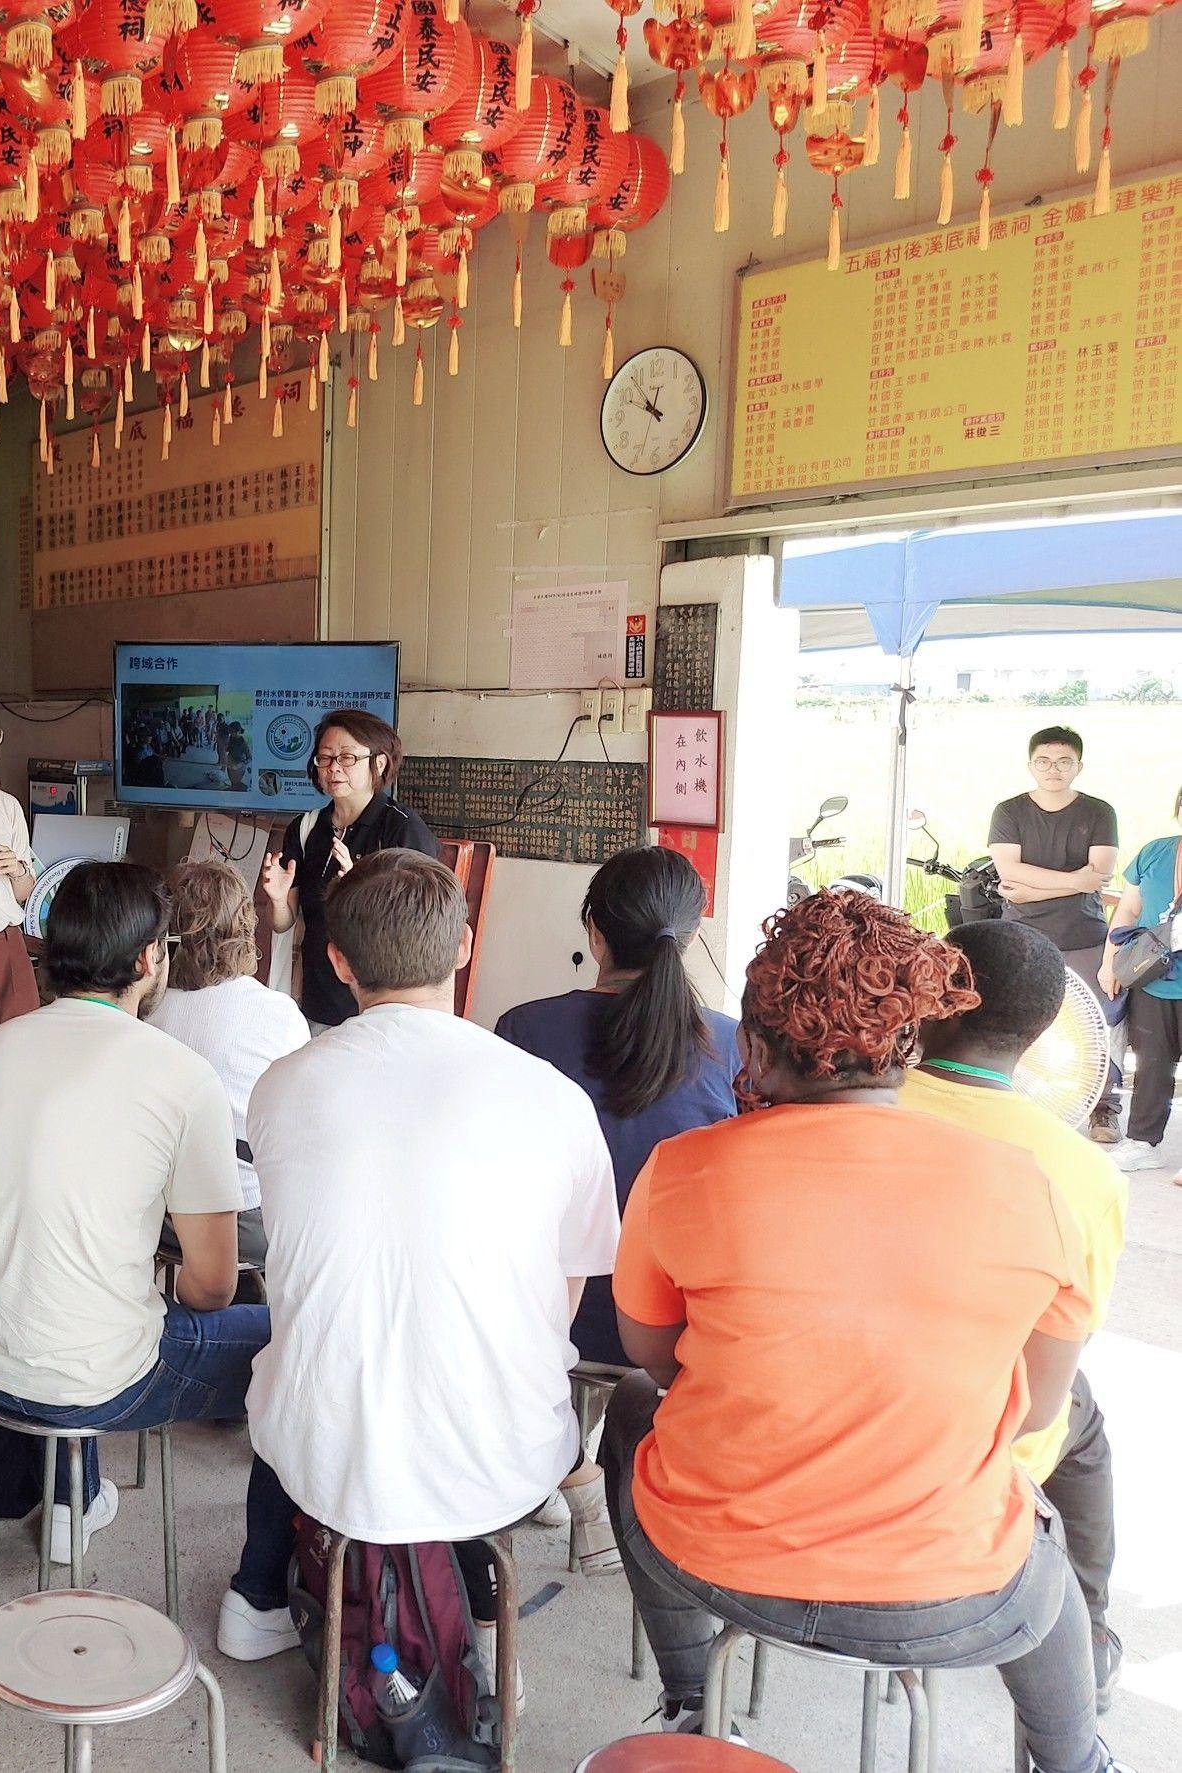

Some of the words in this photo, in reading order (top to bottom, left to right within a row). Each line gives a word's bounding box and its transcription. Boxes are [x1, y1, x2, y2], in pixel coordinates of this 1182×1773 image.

[483, 41, 515, 129] 國泰民安
[577, 108, 604, 187] 國泰民安
[129, 657, 178, 670] 跨域合作
[675, 734, 687, 796] 在內側
[693, 728, 708, 794] 飲水機
